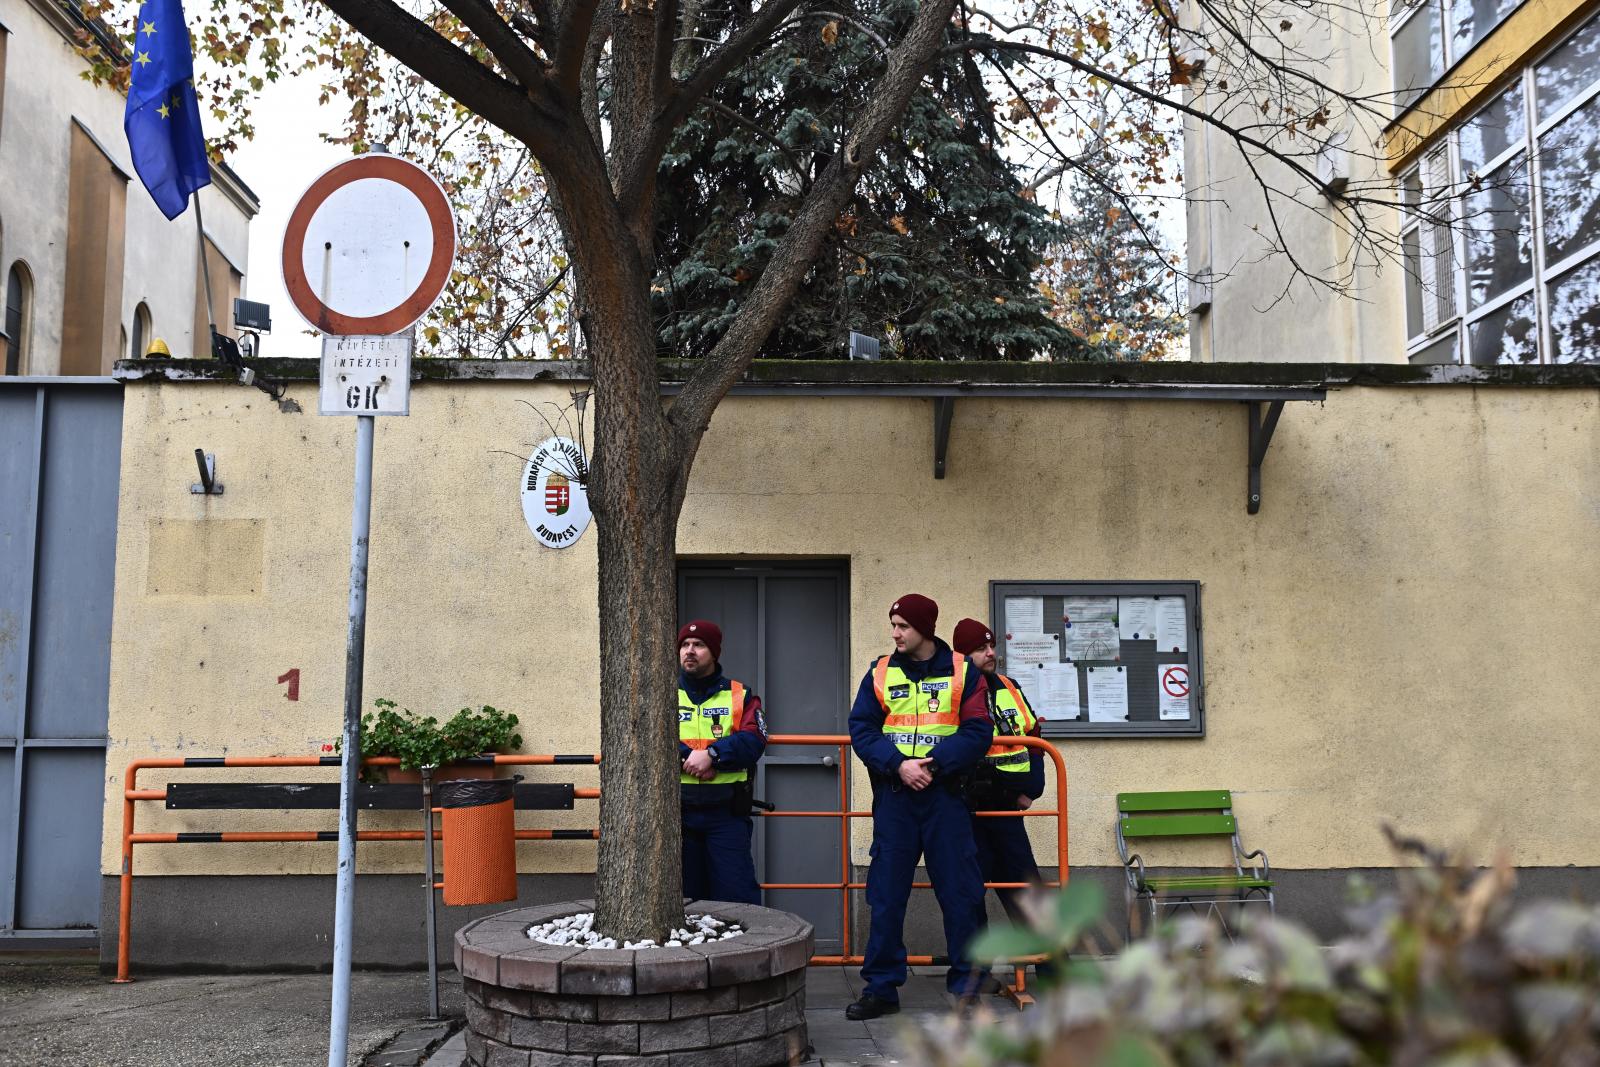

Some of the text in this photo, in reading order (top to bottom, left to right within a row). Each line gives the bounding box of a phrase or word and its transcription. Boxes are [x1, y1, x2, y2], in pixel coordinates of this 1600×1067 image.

[346, 385, 379, 409] GK
[535, 523, 578, 543] BUDAPEST
[277, 668, 300, 702] 1
[921, 682, 949, 692] POLICE
[702, 708, 729, 716] POLICE
